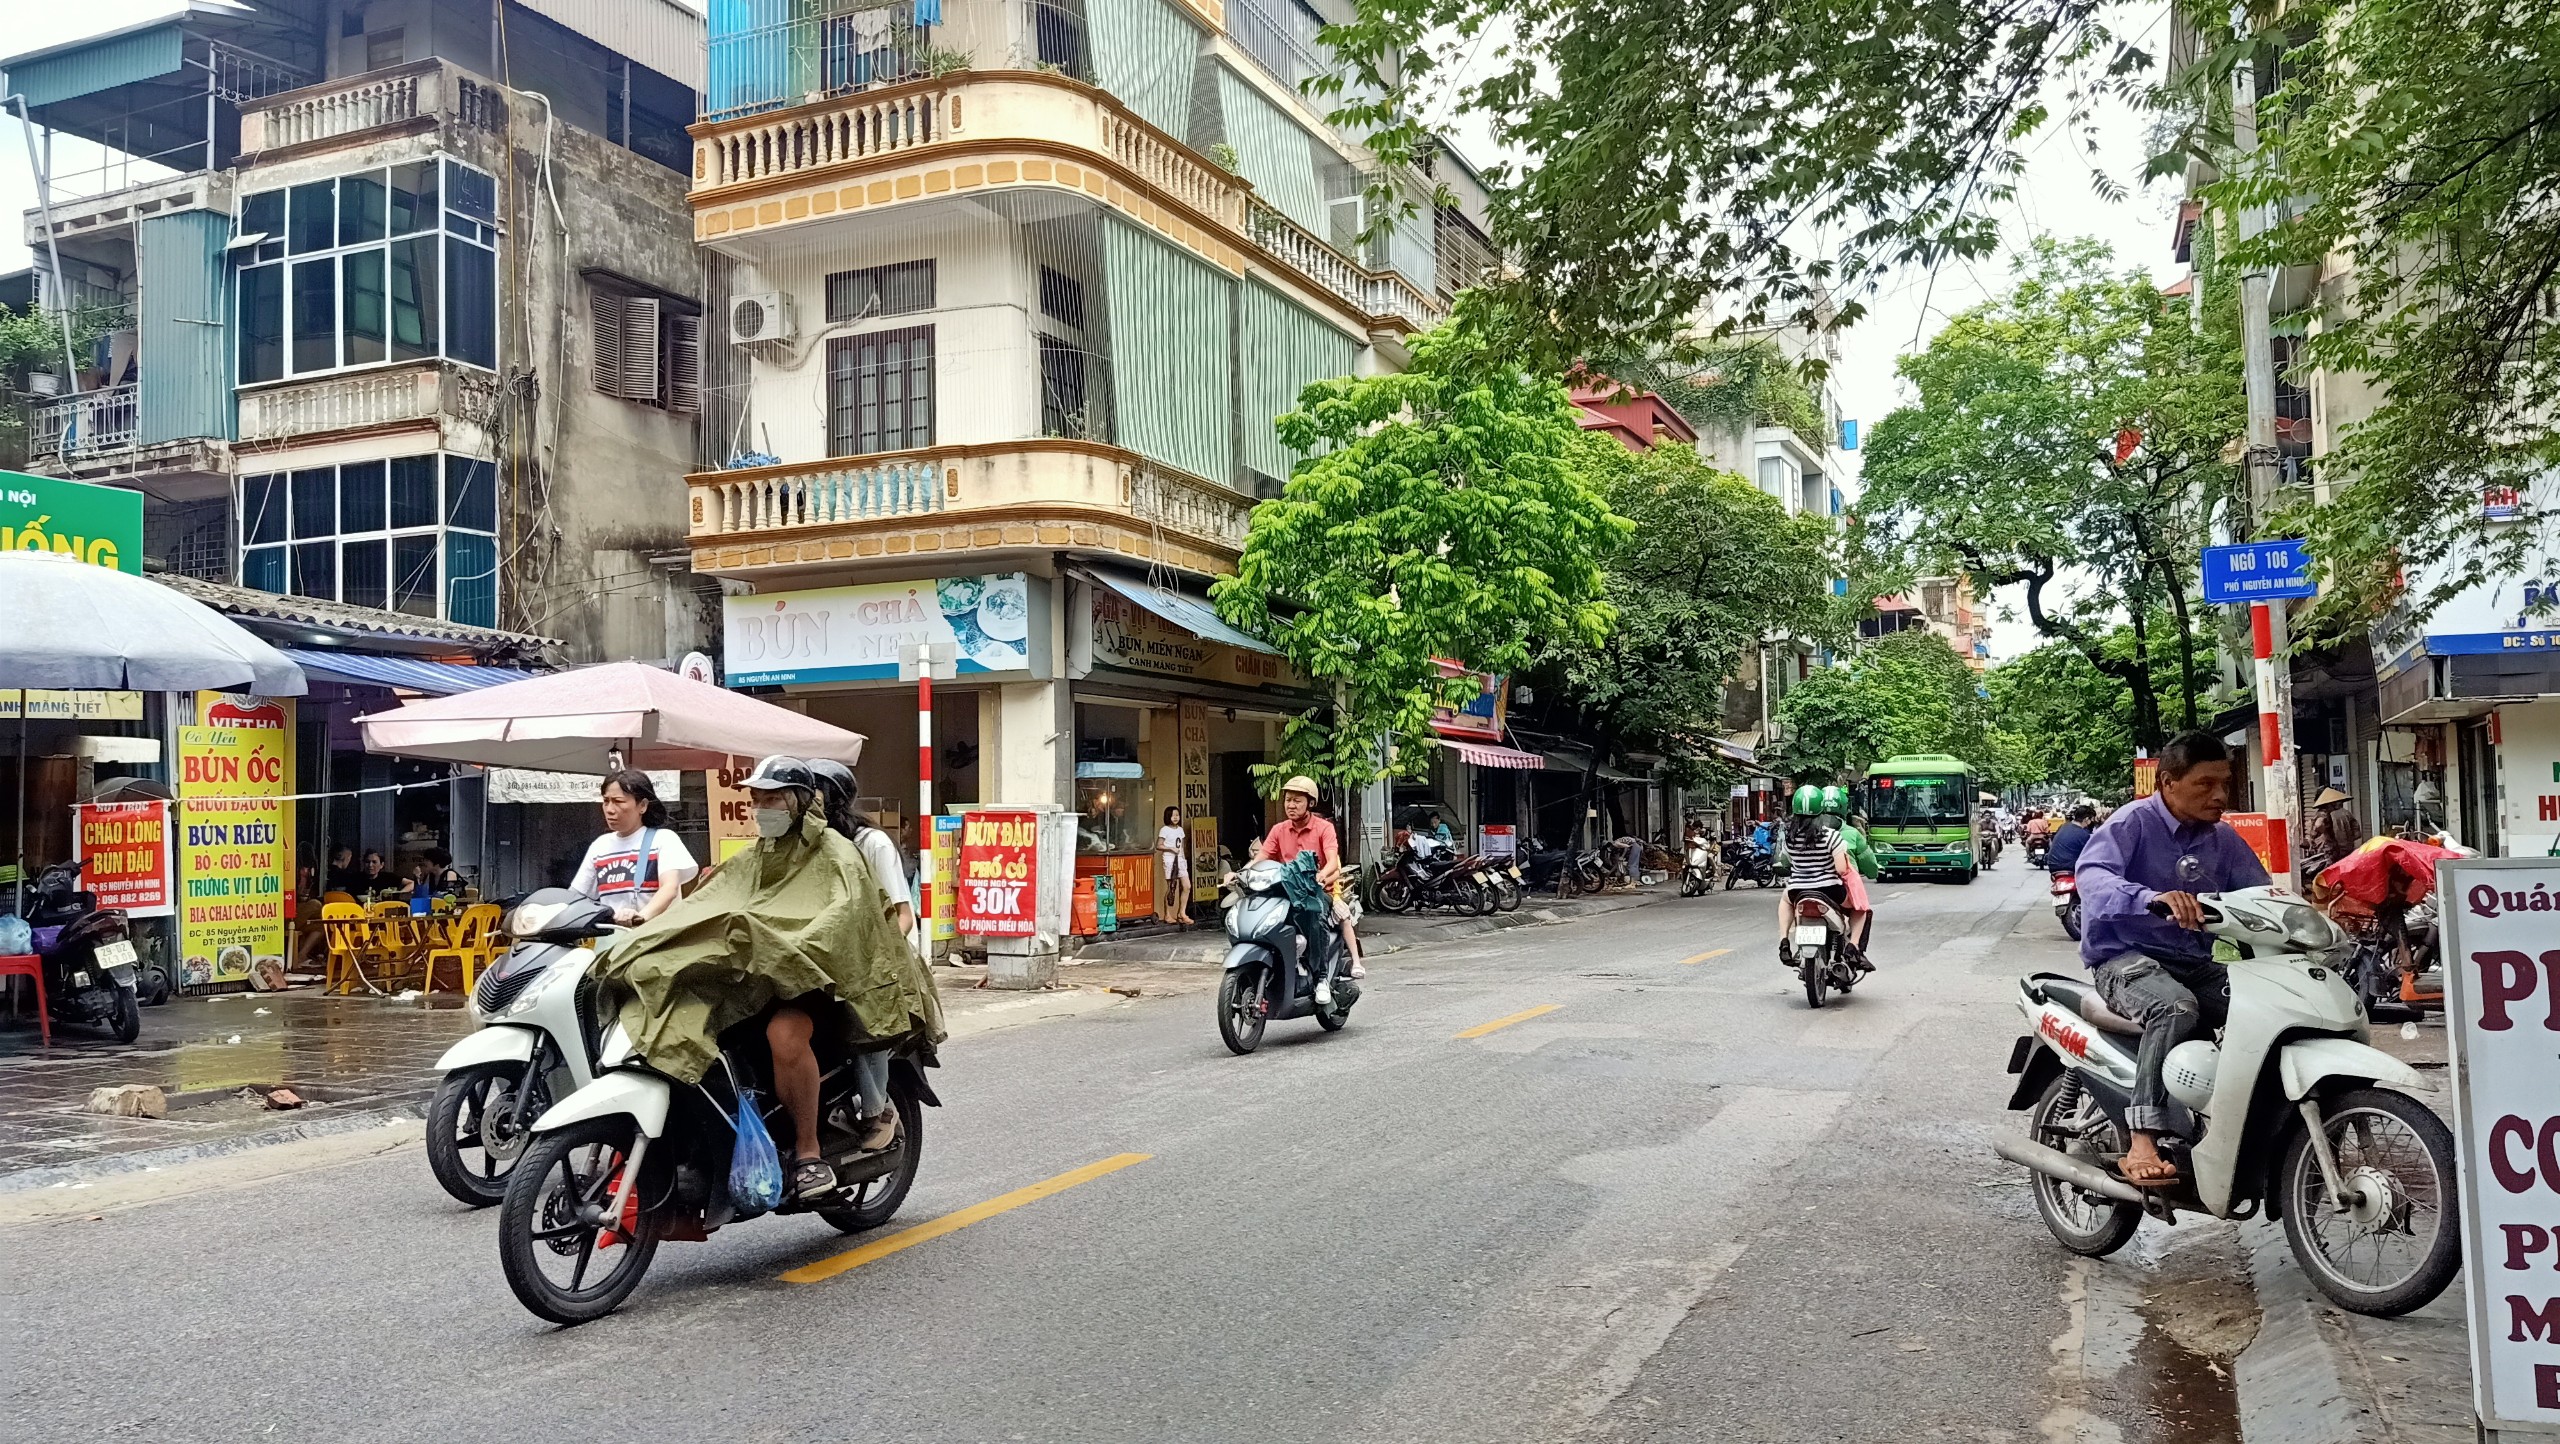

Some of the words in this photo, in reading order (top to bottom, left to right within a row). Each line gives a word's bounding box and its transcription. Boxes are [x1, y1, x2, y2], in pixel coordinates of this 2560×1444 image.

[8, 489, 37, 508] NỘI
[2229, 549, 2256, 572] NGÕ
[2265, 550, 2289, 569] 106
[2242, 575, 2273, 591] NGUYỄN
[2273, 579, 2282, 589] AN
[857, 588, 928, 626] CHẢ
[737, 600, 831, 662] BÚN
[1147, 637, 1173, 657] MIẾN
[1174, 645, 1204, 662] NGAN
[1128, 656, 1152, 668] CANH
[1235, 653, 1261, 677] CHÂN
[738, 675, 746, 684] 85
[771, 674, 780, 682] AN
[1184, 700, 1206, 721] BÚN
[184, 748, 240, 784] BÚN
[247, 744, 281, 783] ỐC
[1185, 779, 1207, 799] BÚN
[1186, 803, 1208, 819] NEM
[1821, 799, 1838, 808] rab
[2538, 795, 2560, 822] H
[84, 817, 124, 846] CHÁO
[126, 816, 162, 845] LÒNG
[188, 819, 229, 846] BÚN
[233, 817, 277, 845] RIÊU
[938, 818, 947, 830] 85
[964, 815, 1000, 847] BÚN
[1000, 815, 1036, 853] ĐẬU
[1176, 837, 1181, 849] C
[93, 847, 124, 875] BÚN
[126, 845, 154, 878] ĐẬU
[195, 850, 212, 871] BÒ
[220, 848, 242, 870] GIÒ
[251, 852, 272, 869] TAI
[968, 853, 1004, 878] PHỐ
[1005, 852, 1028, 879] CỔ
[187, 873, 230, 898] TRỨNG
[233, 876, 252, 899] VỊT
[255, 872, 279, 898] LỘN
[606, 872, 626, 884] CLUB
[964, 878, 989, 887] TRONG
[1135, 857, 1152, 897] QUAY
[971, 887, 1022, 915] 30K
[2264, 887, 2290, 898] XE
[2468, 882, 2560, 919] Quá
[189, 906, 207, 923] BIA
[209, 904, 232, 922] CHAI
[234, 899, 255, 920] CÁC
[255, 902, 278, 922] LOẠI
[206, 928, 216, 937] 85
[248, 925, 259, 934] An
[260, 925, 279, 933] Ninh
[959, 916, 970, 931] CÓ
[1018, 917, 1035, 933] HÒA
